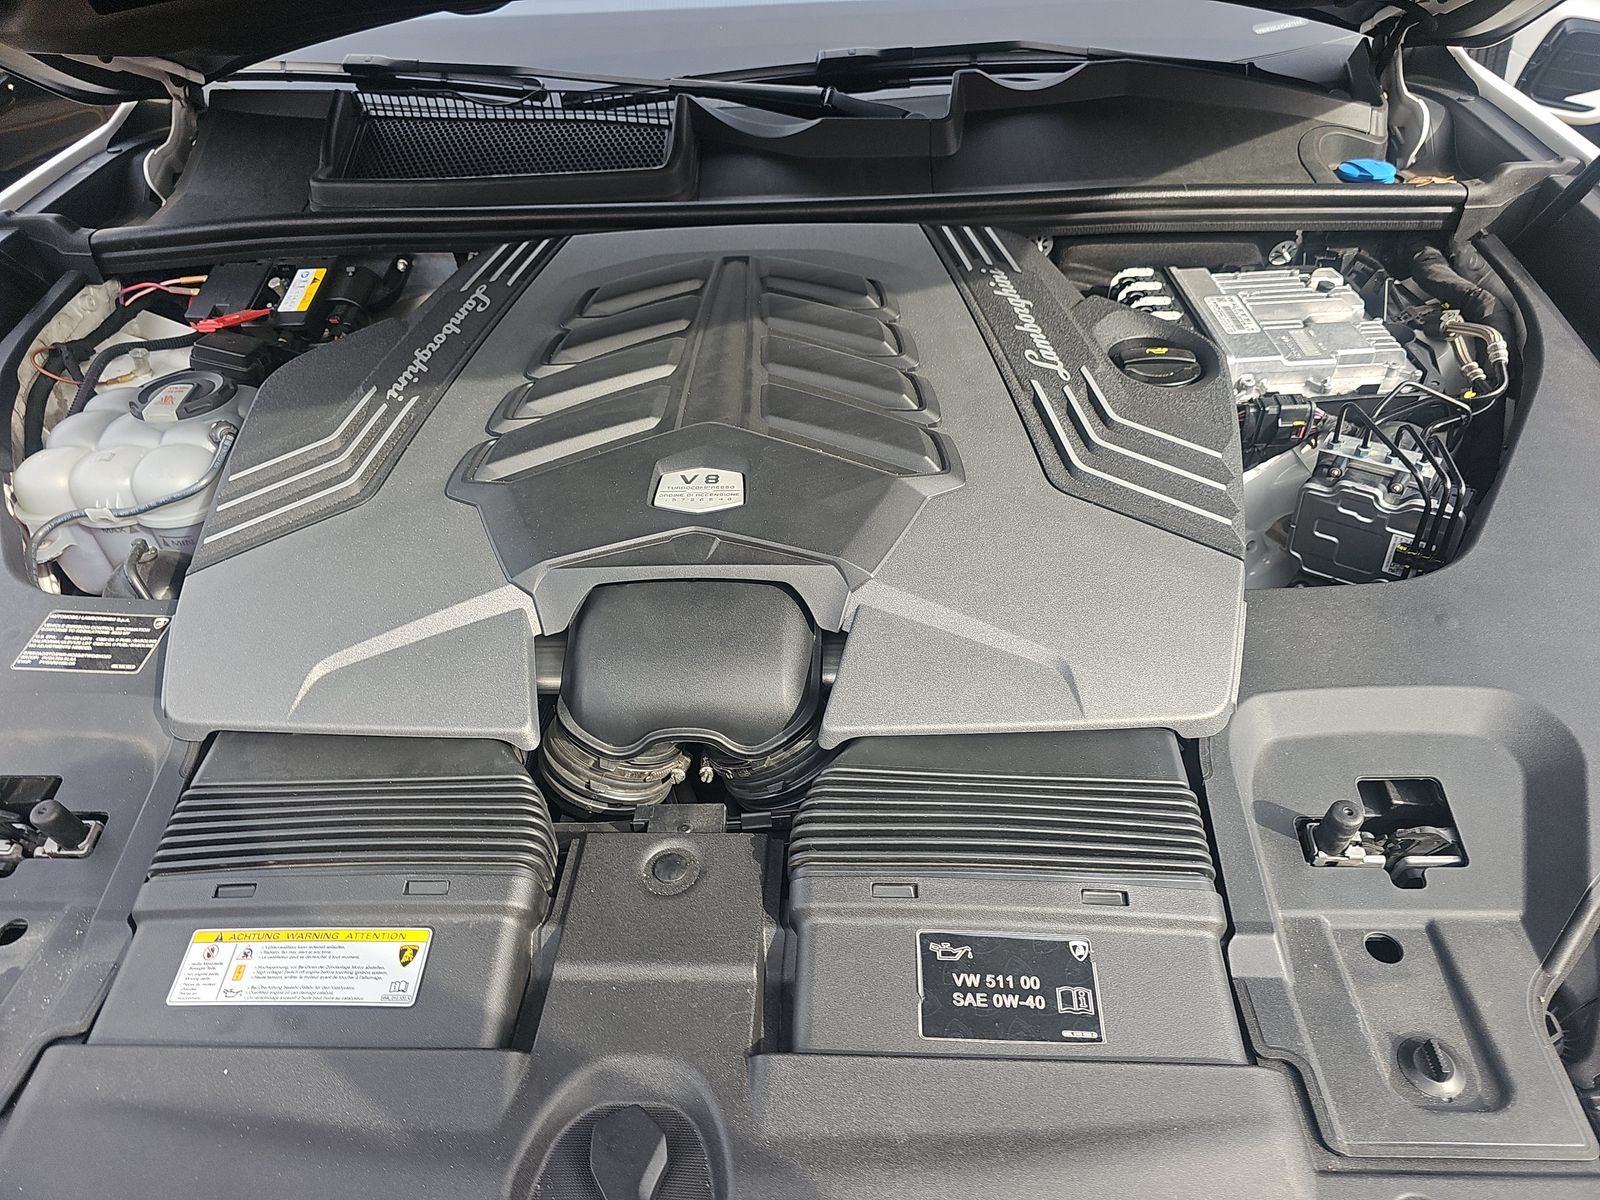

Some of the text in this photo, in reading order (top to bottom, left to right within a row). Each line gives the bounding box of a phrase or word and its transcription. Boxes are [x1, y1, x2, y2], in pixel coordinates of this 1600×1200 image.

[981, 267, 1071, 381] Lamborghini
[387, 284, 491, 400] Lamborghini
[171, 538, 195, 546] MIN
[229, 932, 407, 941] ACHTUNG WARNING ATTENTION
[952, 972, 1041, 990] VW 511 00
[952, 992, 1046, 1010] SAE 0W-40
